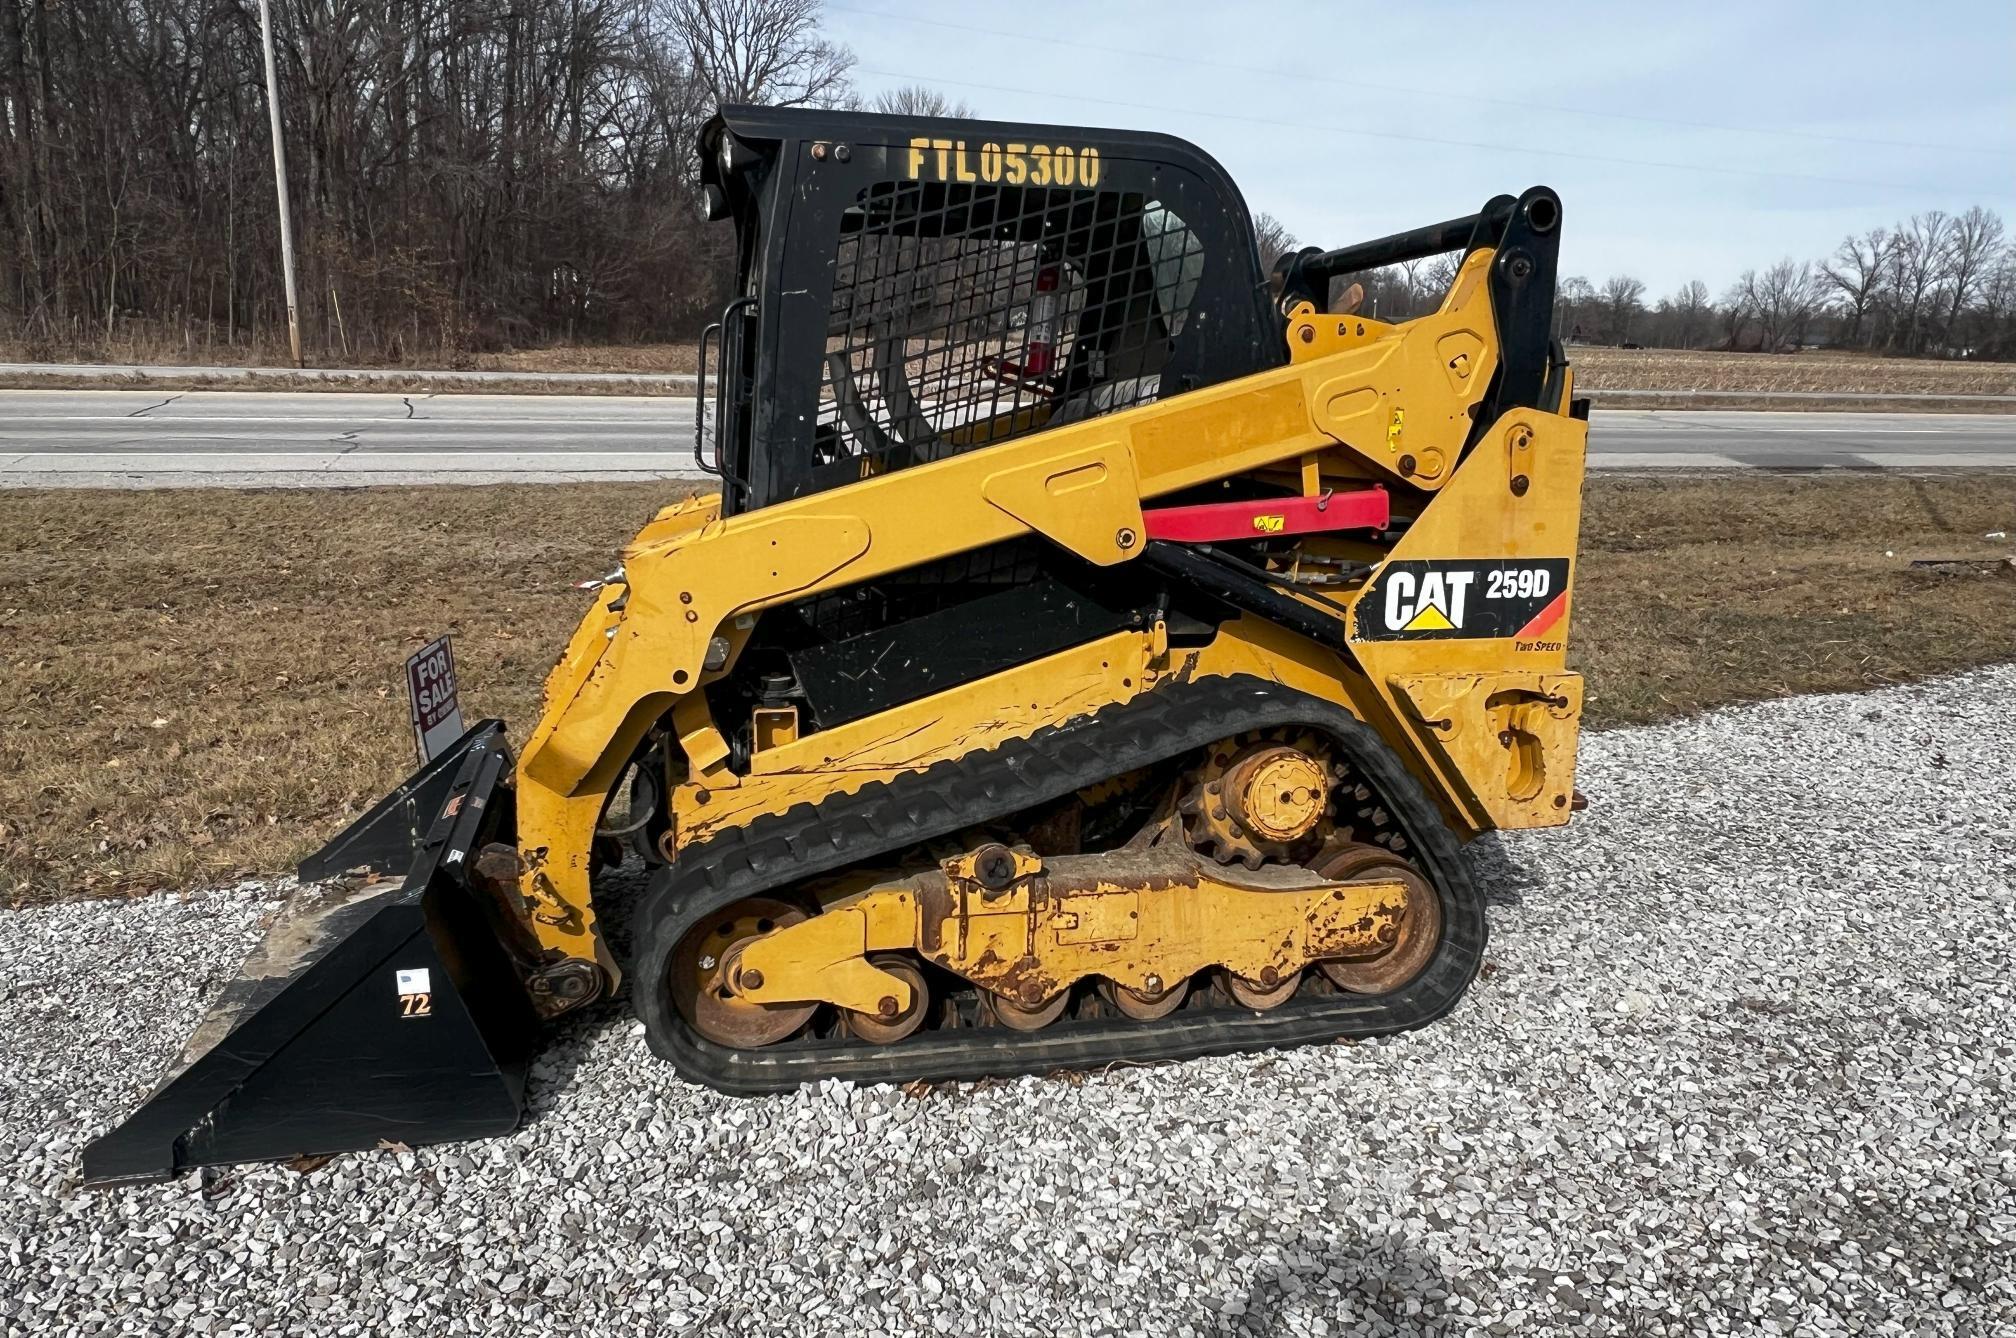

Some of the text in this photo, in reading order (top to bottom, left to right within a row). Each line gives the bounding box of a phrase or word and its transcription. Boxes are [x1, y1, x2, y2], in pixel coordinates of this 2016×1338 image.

[909, 138, 1099, 187] FTL05300
[1385, 569, 1549, 630] CAT 259D
[418, 650, 447, 687] FOR
[419, 671, 453, 713] SALE
[400, 993, 431, 1015] 72
